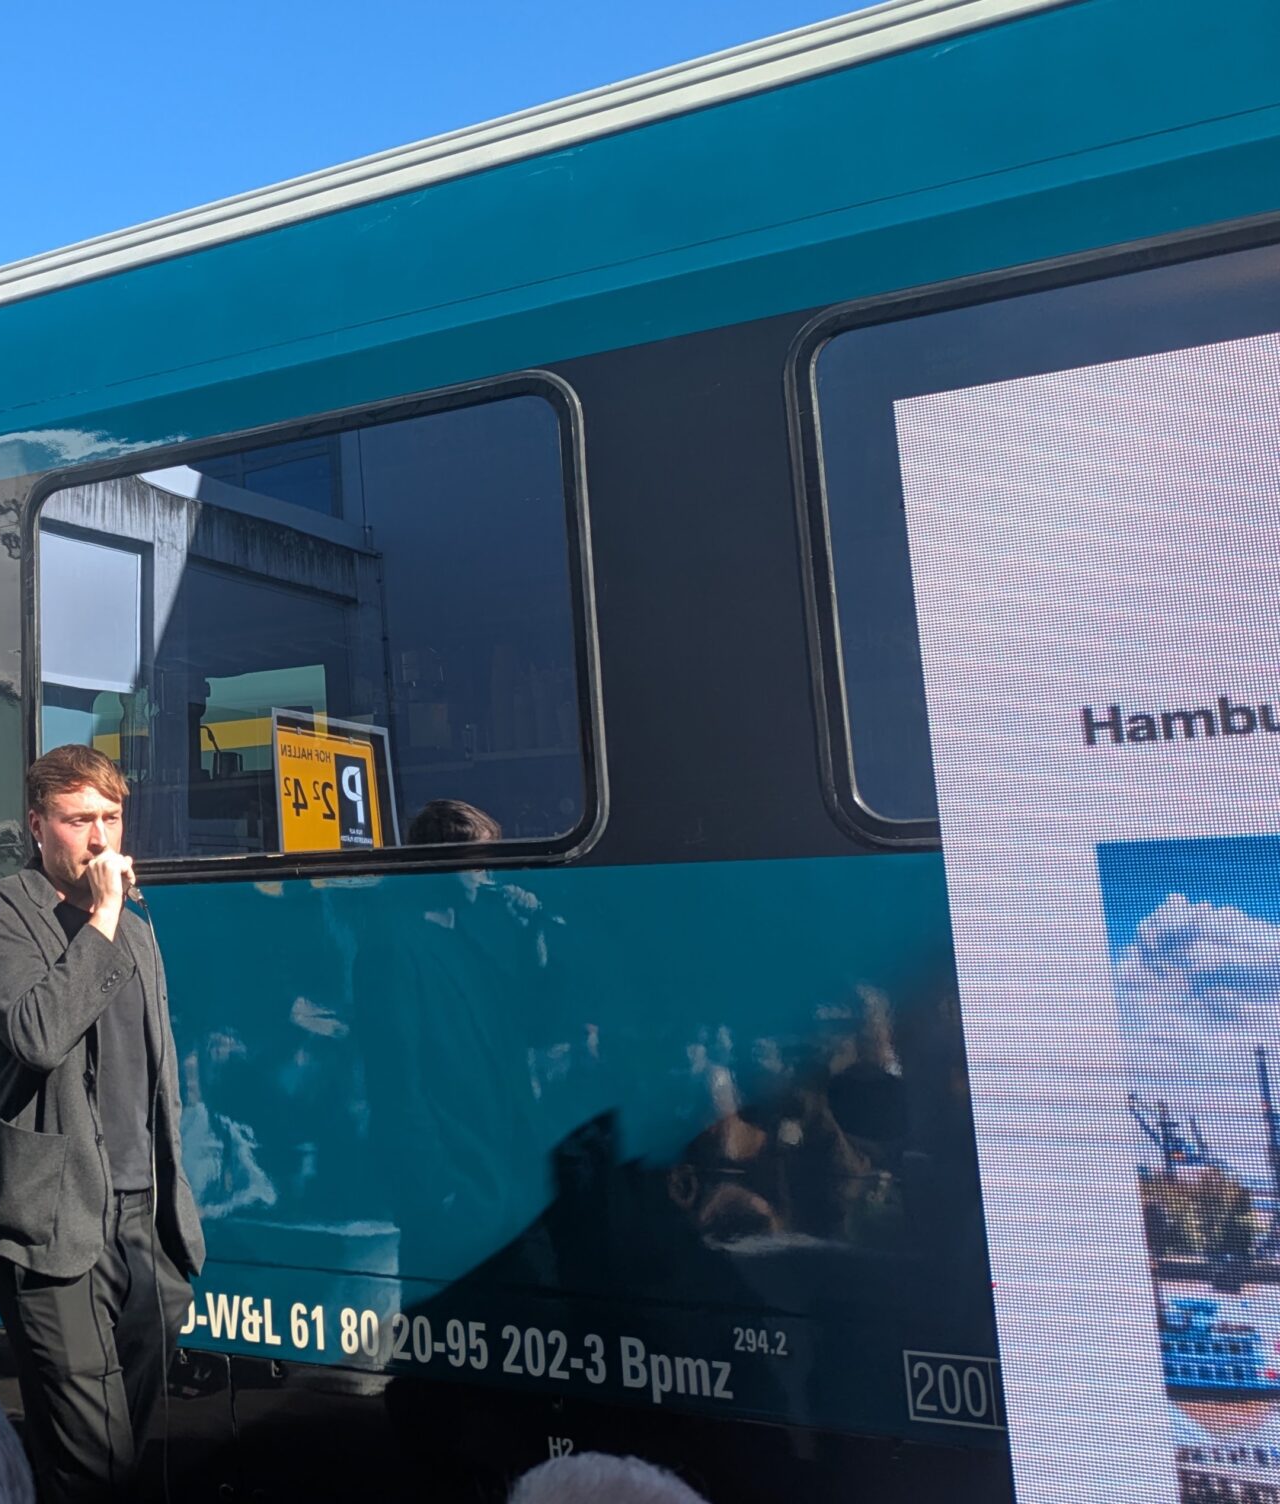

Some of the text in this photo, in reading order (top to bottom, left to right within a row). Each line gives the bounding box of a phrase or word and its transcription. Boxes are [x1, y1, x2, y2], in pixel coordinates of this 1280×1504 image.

[290, 1302, 325, 1351] 61
[340, 1307, 379, 1357] 80
[392, 1312, 489, 1370] 20-95
[501, 1324, 607, 1385] 202-3
[620, 1335, 734, 1404] Bpmz
[733, 1327, 788, 1356] 294.2
[913, 1361, 987, 1417] 200
[548, 1435, 573, 1459] H2
